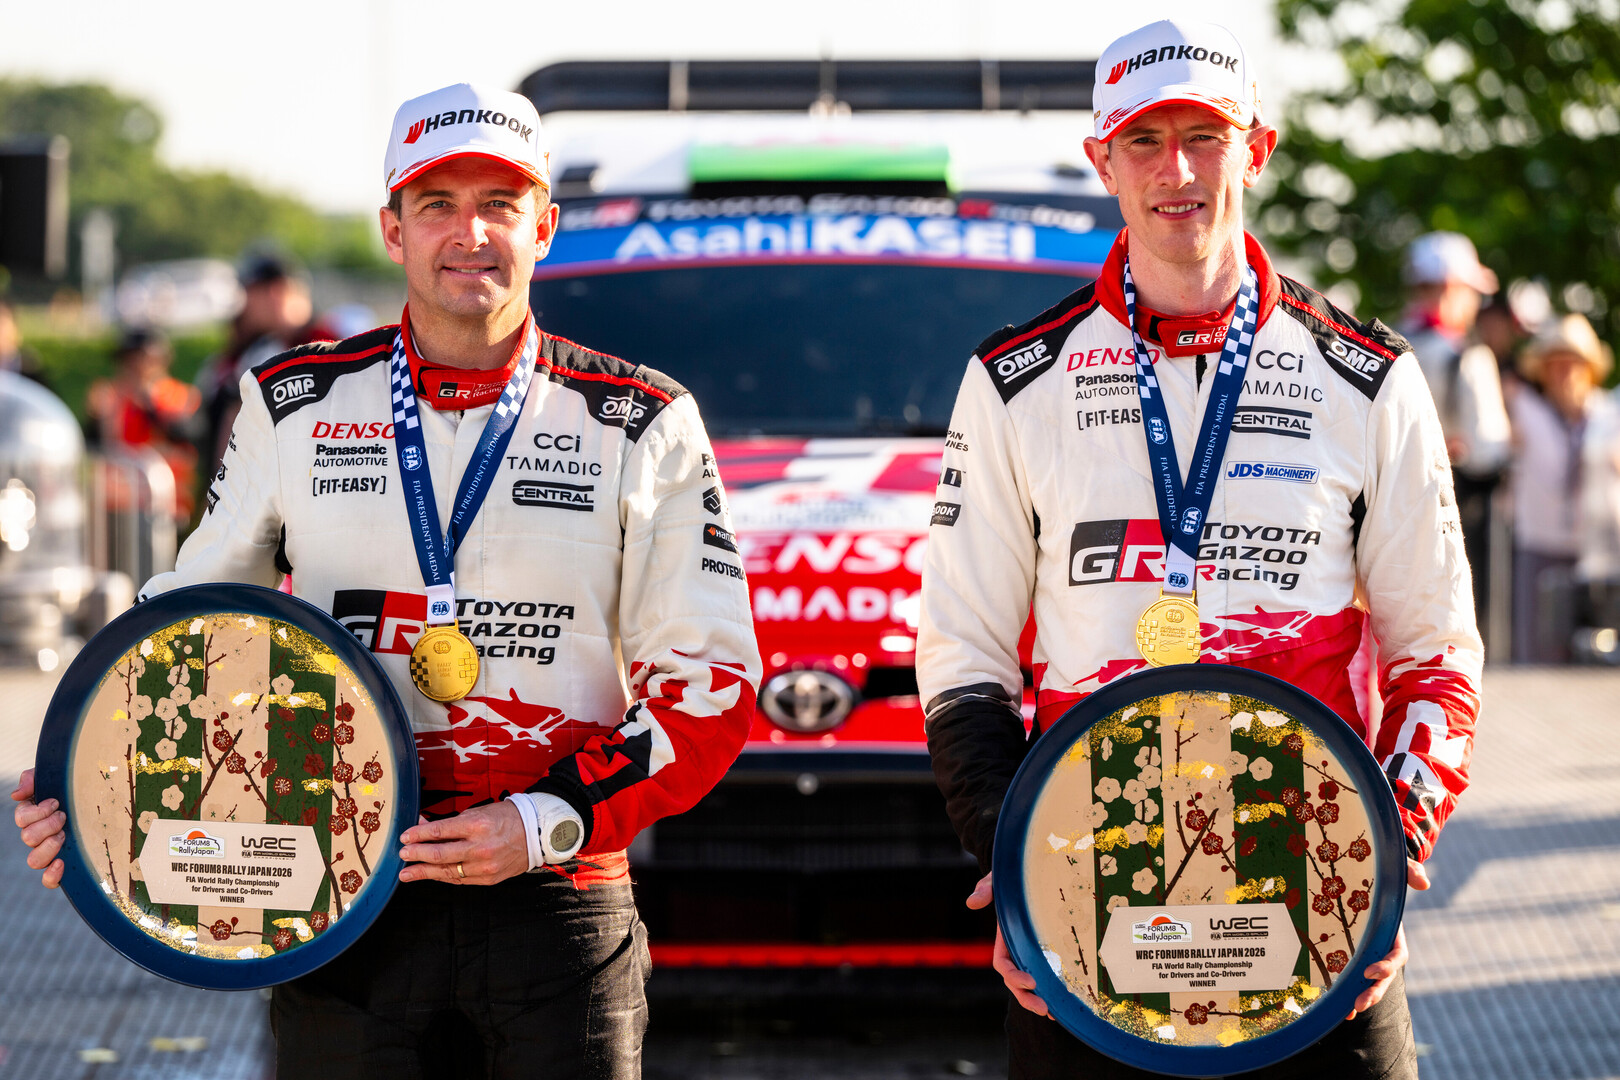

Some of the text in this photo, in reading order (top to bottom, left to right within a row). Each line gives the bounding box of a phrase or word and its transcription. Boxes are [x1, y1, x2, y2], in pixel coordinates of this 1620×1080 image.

[1178, 334, 1210, 344] GR
[997, 344, 1047, 377] OMP
[1331, 341, 1380, 373] OMP
[1075, 373, 1138, 387] Panason
[273, 378, 315, 402] OMP
[440, 388, 471, 399] GR
[1240, 380, 1323, 402] AMADIC
[602, 400, 644, 422] OMP
[1077, 408, 1141, 431] [FIT-EAS
[311, 421, 396, 439] DENSO
[316, 443, 387, 455] Panasonic
[1195, 481, 1205, 495] FIA
[1215, 393, 1228, 422] MEDAL
[313, 457, 388, 467] AUTOMOTIVE
[507, 456, 602, 476] TAMADIC
[1160, 457, 1168, 471] FIA
[453, 510, 464, 524] FIA
[485, 432, 500, 459] MEDAL
[1228, 463, 1316, 480] JDS MACHINERY
[512, 487, 594, 503] CENTRAL
[413, 480, 422, 495] FIA
[428, 551, 440, 583] MEDAL
[1203, 522, 1321, 545] TOYOTA
[1198, 543, 1307, 565] GAZOO
[1072, 545, 1166, 582] GR
[1196, 564, 1299, 591] Racing
[455, 598, 574, 620] TOYOTA
[478, 640, 555, 665] acing
[183, 839, 210, 847] FORUM8
[241, 835, 296, 850] WRC
[171, 862, 292, 877] WRC FORUM8 RALLY JAPAN 2026
[217, 877, 233, 886] Rally
[234, 878, 280, 888] Championship
[219, 895, 245, 903] WINNER
[240, 888, 273, 896] Co-Drivers
[1210, 916, 1268, 931] WRC
[1136, 947, 1266, 960] WRC FORUM8 RALLY JAPAN 2026
[1186, 961, 1203, 971] Rally
[1204, 961, 1253, 970] Championship
[1210, 970, 1246, 978] Co-Drivers
